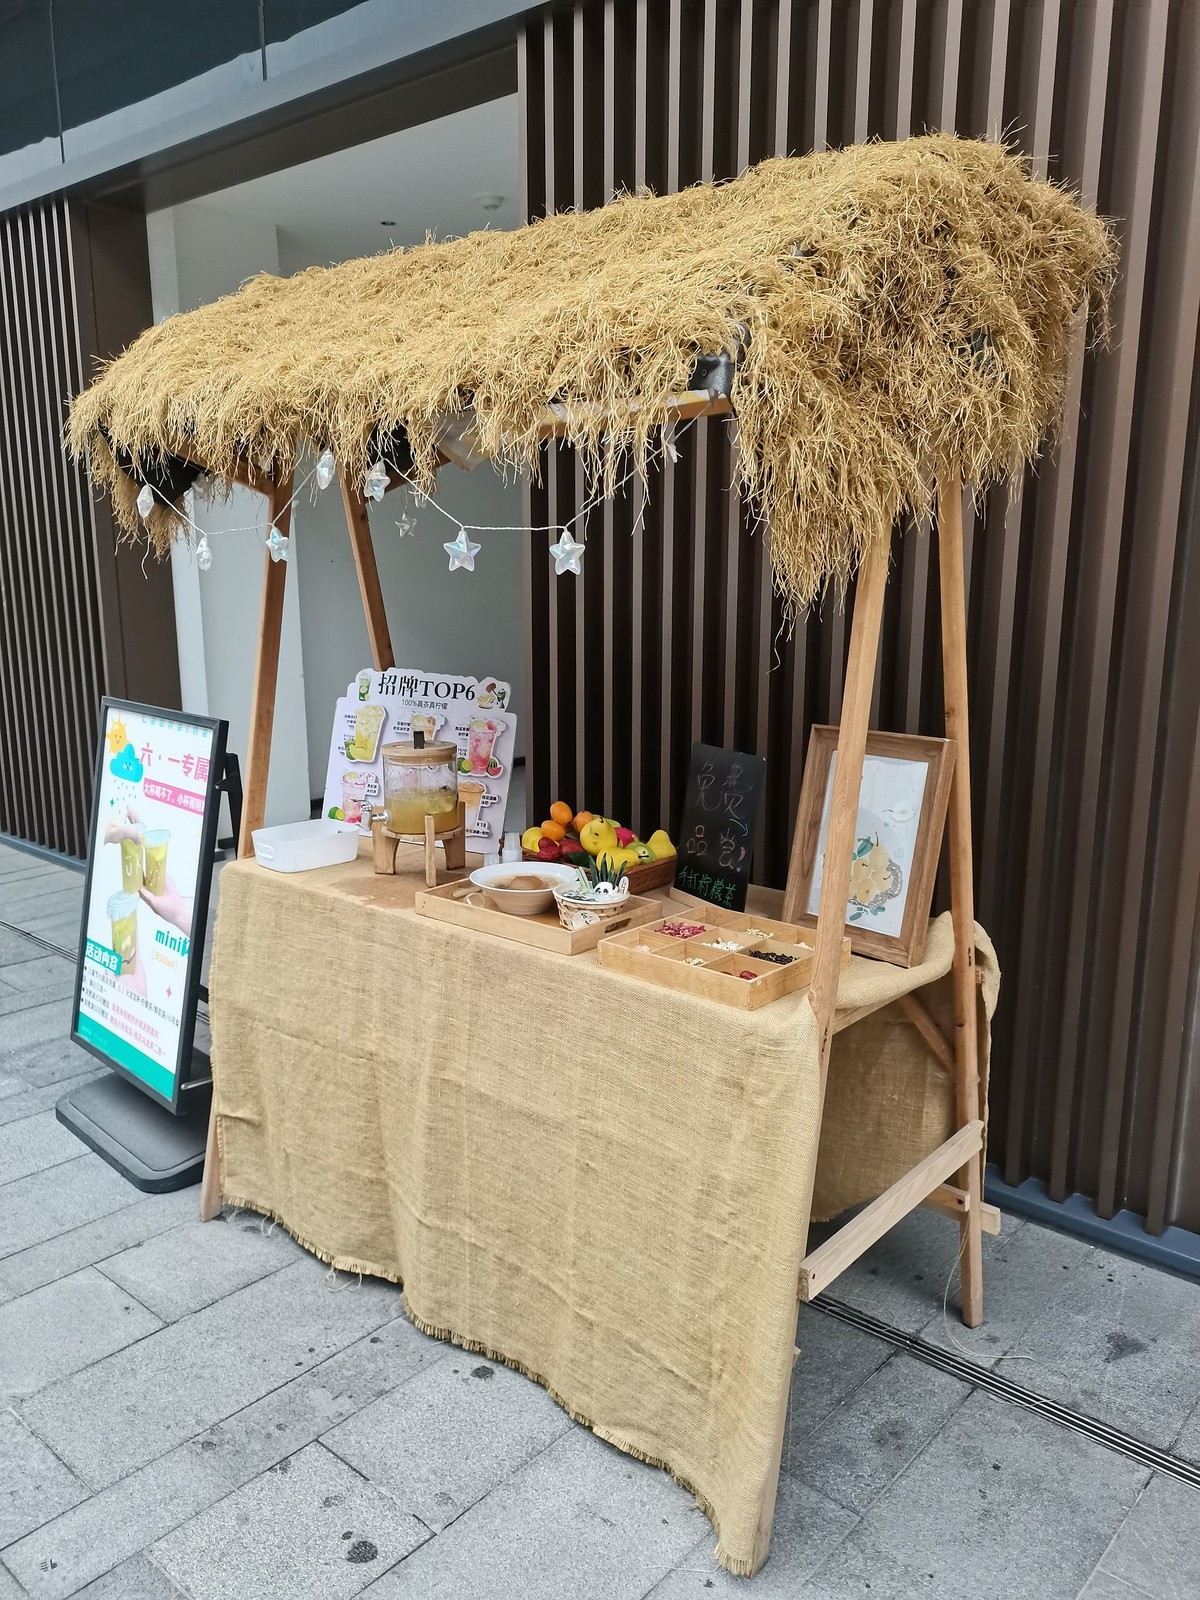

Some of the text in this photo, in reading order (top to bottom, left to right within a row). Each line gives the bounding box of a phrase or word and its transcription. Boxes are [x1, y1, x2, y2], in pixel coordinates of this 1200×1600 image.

[378, 673, 476, 701] 招牌TOP6
[678, 866, 736, 908] 手打柠檬茶
